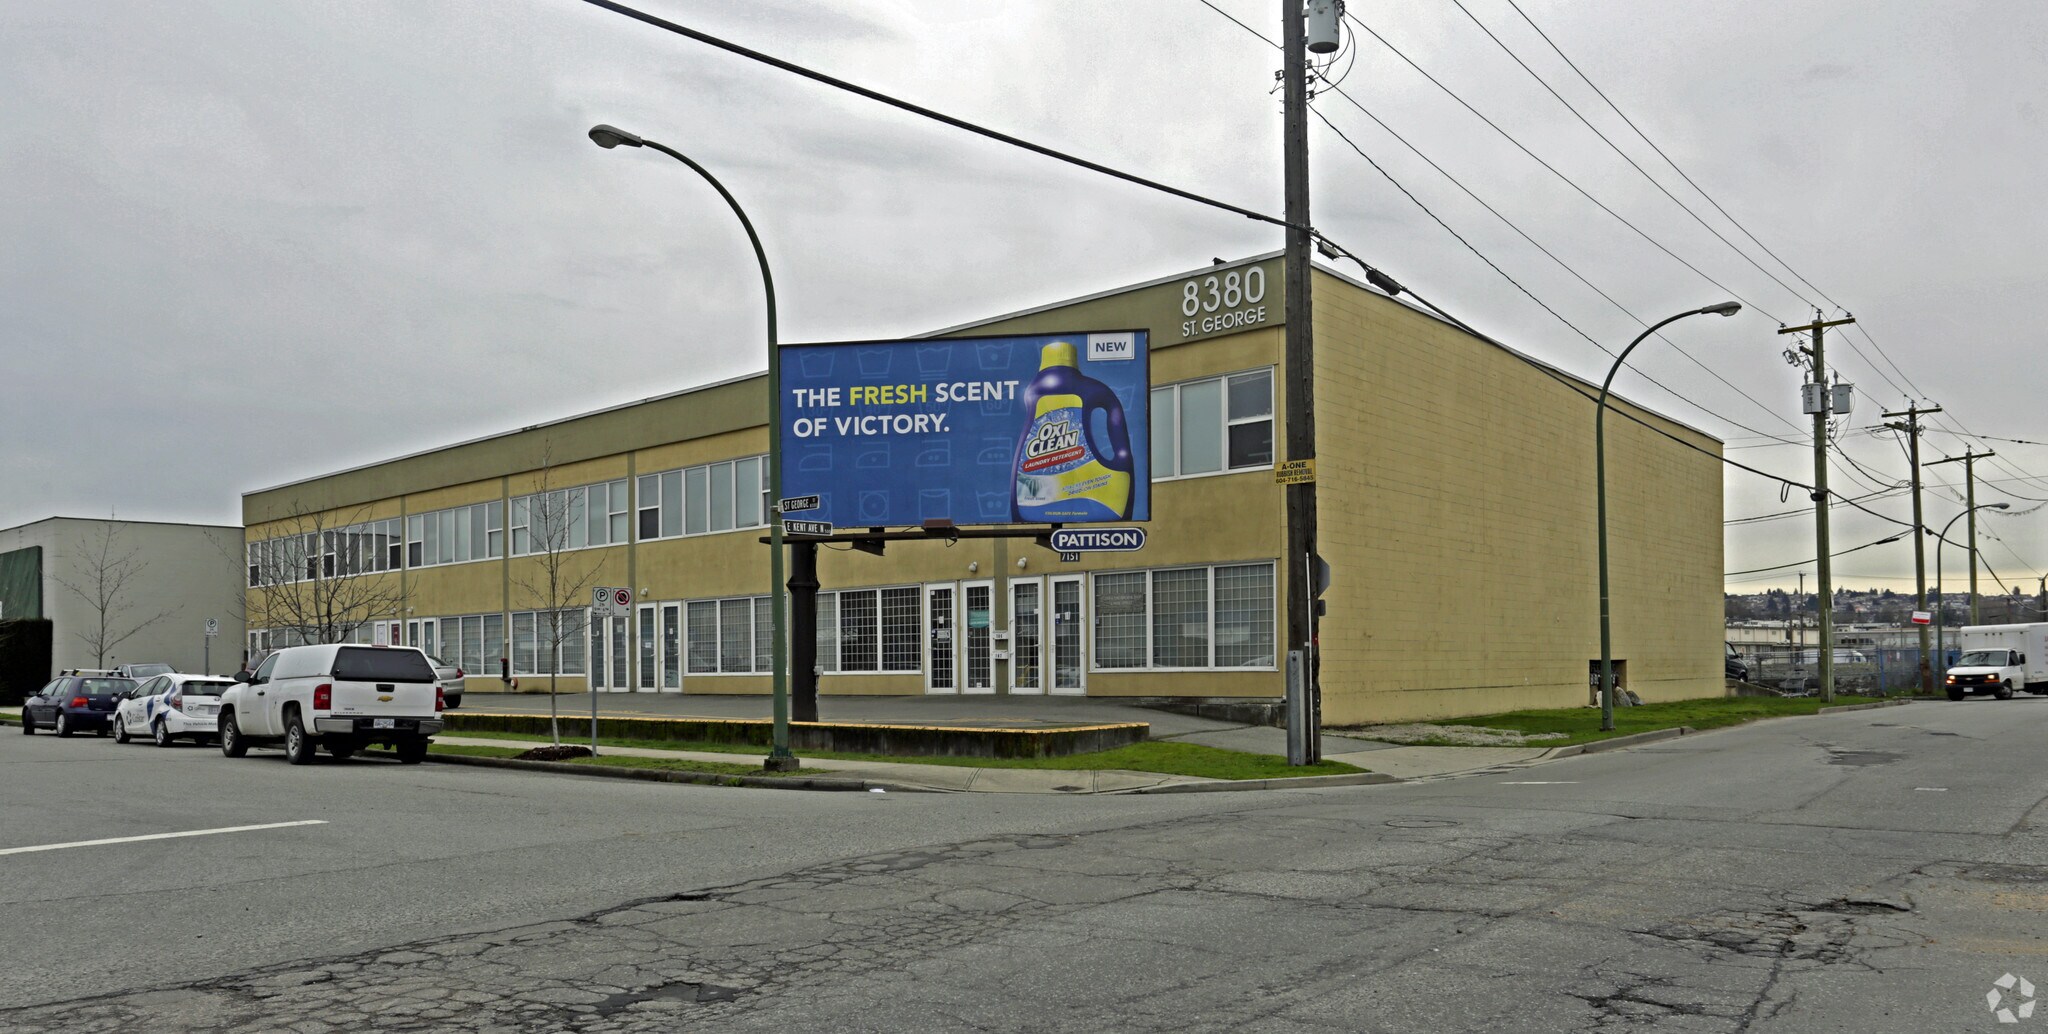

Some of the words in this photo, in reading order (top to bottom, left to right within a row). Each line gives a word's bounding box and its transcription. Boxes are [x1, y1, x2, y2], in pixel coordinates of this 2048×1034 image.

[1182, 265, 1265, 317] 8380
[1182, 320, 1198, 337] ST.
[1201, 306, 1266, 333] GEORGE
[1095, 341, 1127, 353] NEW
[792, 387, 841, 408] THE
[850, 384, 927, 406] FRESH
[935, 380, 1020, 403] SCENT
[793, 417, 828, 438] OF
[834, 413, 950, 436] VICTORY.
[1039, 421, 1069, 440] OXI
[1027, 431, 1079, 458] CLEAN
[1024, 457, 1051, 469] LAUNDRY
[1051, 449, 1083, 462] DETERGENT
[1282, 461, 1307, 470] A-ONE
[784, 501, 790, 511] ST
[790, 498, 809, 510] GEORGE
[787, 522, 791, 532] E
[793, 522, 807, 532] KENT
[808, 523, 818, 533] AVE
[820, 524, 824, 533] N
[1058, 532, 1137, 547] PATTISON
[1061, 552, 1079, 561] 7151
